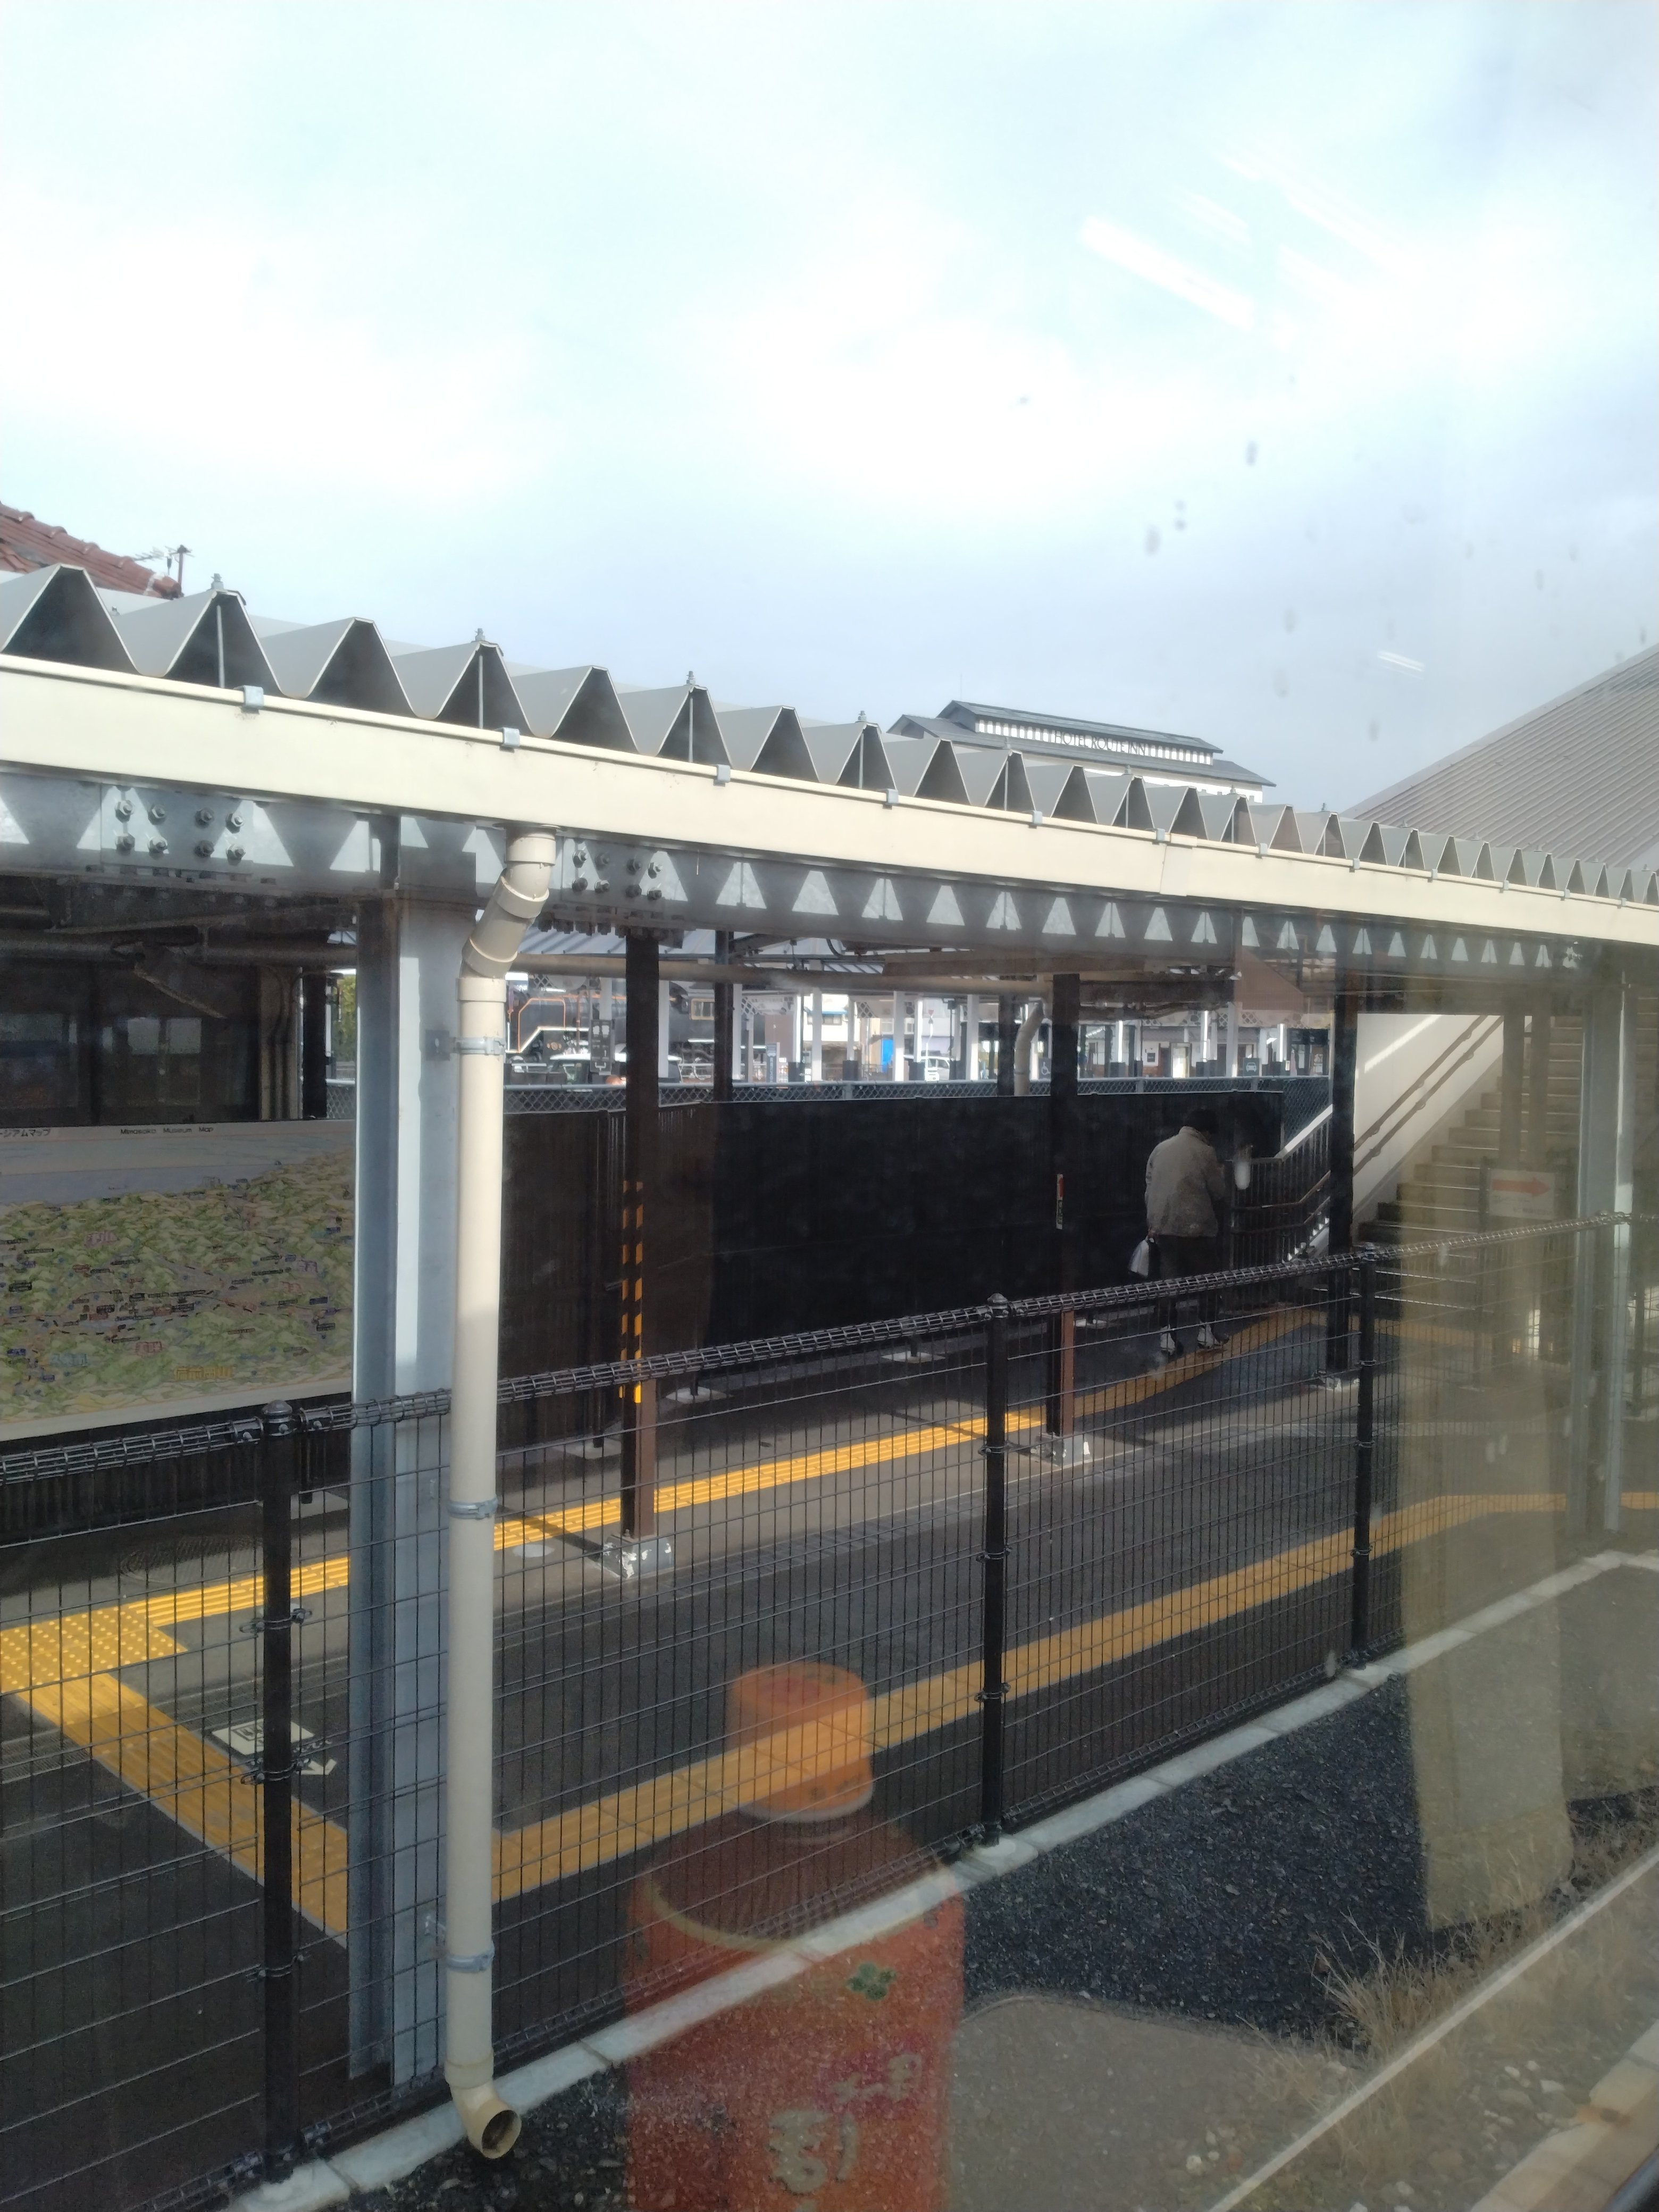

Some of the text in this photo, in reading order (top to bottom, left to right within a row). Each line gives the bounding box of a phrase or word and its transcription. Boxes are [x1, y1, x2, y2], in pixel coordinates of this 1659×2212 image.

[1054, 731, 1146, 756] HOTEL ROUTE INN
